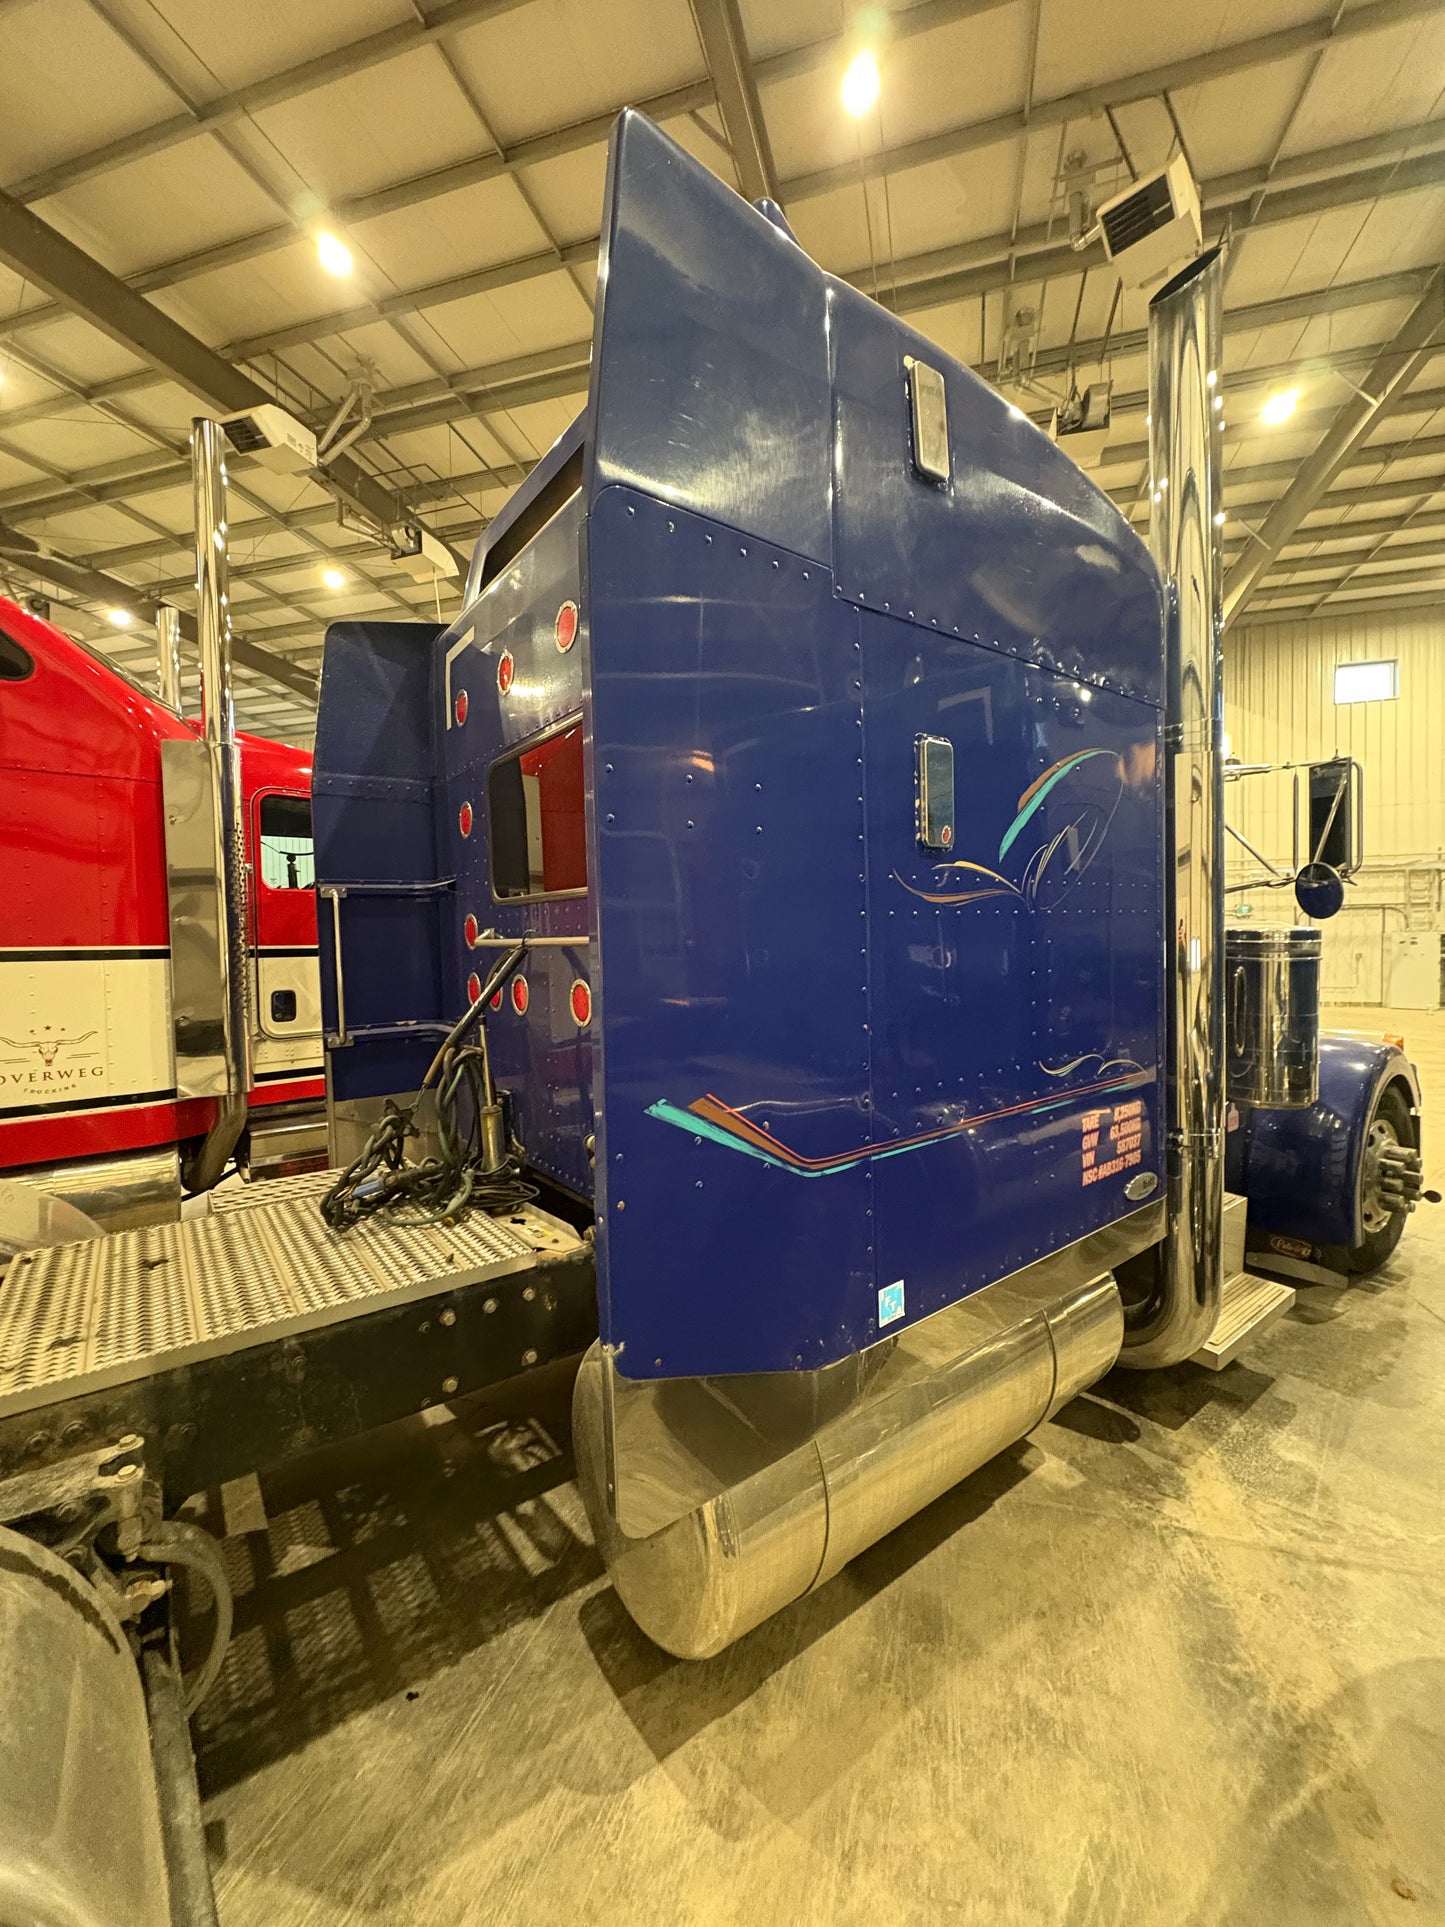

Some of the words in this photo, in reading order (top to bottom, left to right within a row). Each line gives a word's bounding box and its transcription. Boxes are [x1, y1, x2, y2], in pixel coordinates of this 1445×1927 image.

[23, 1083, 77, 1095] TRUCKING
[1082, 1113, 1100, 1133] TARE
[1082, 1131, 1100, 1150] GVW
[1082, 1150, 1095, 1168] VIN
